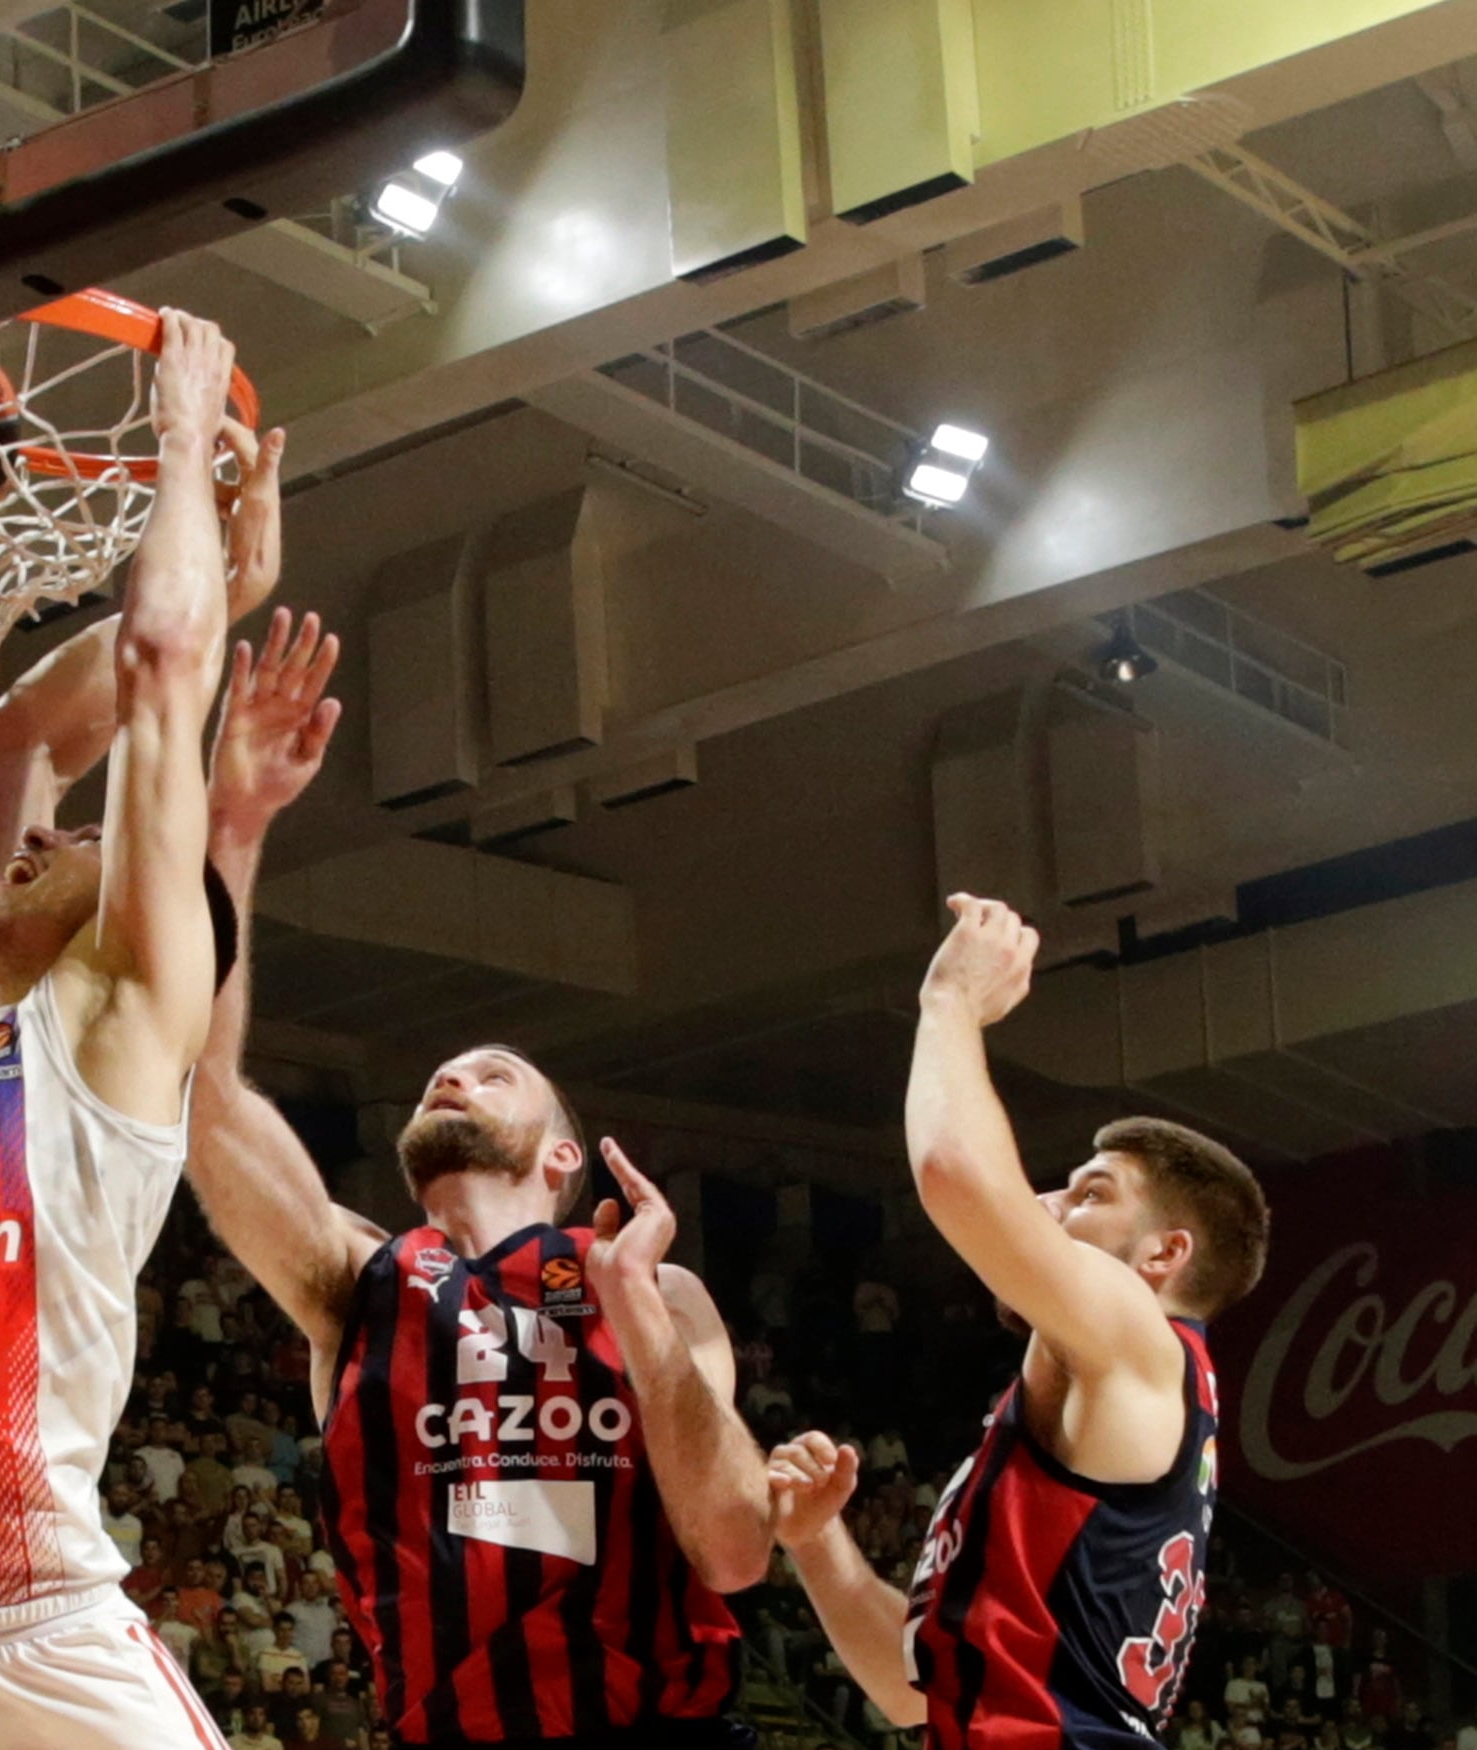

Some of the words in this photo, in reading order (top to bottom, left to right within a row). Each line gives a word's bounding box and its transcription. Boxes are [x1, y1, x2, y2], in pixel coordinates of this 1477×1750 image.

[457, 1304, 578, 1385] 24
[415, 1395, 632, 1448] CAZOO
[453, 1502, 518, 1519] GLOBAL
